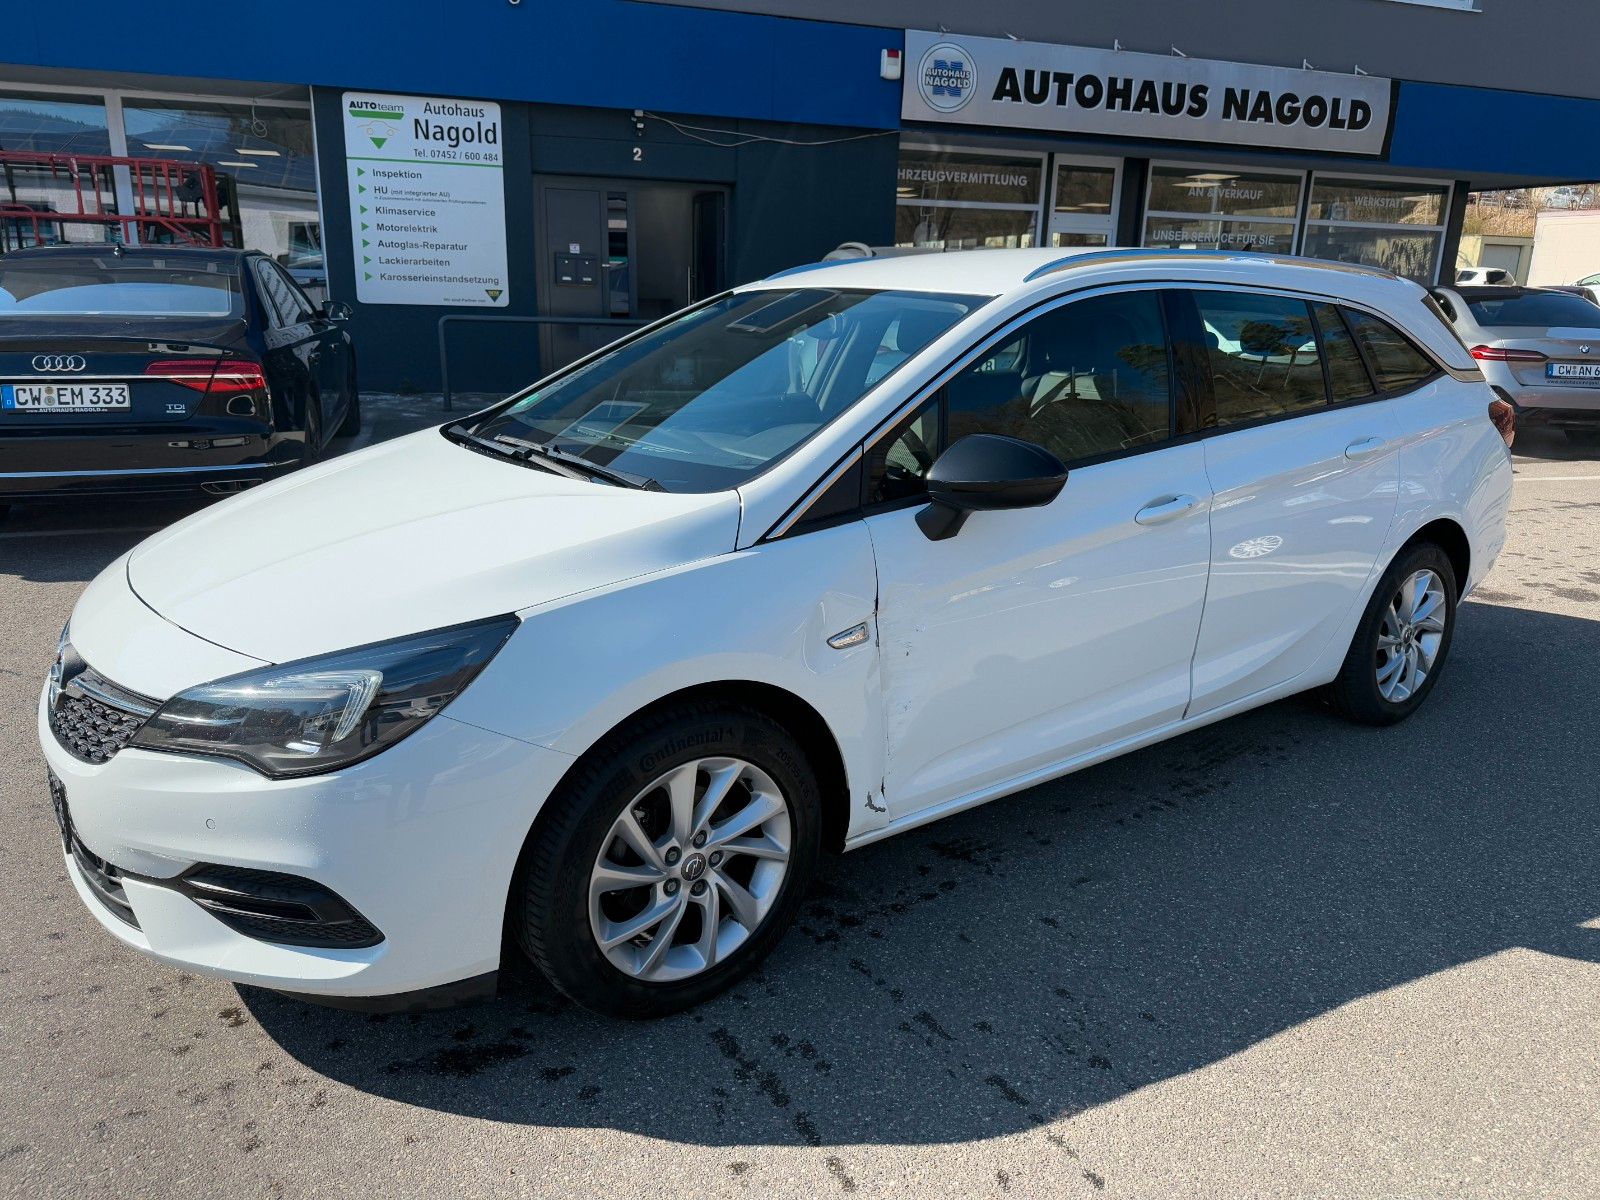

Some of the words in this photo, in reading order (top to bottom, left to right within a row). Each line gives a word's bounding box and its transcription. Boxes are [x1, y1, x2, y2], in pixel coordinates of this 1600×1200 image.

[925, 67, 971, 79] AUTOHAUS
[925, 75, 971, 89] NAGOLD
[349, 100, 404, 112] AUTOteam
[992, 67, 1211, 118] AUTOHAUS
[1222, 87, 1372, 131] NAGOLD
[423, 102, 485, 118] Autohaus
[414, 118, 497, 148] Nagold
[414, 148, 428, 158] Tel.
[430, 150, 457, 160] 07452
[464, 151, 481, 161] 600
[483, 153, 498, 162] 484
[633, 147, 642, 161] 2
[372, 168, 422, 180] Inspektion
[897, 168, 1028, 187] HRZEUGVERMITTLUNG
[374, 186, 388, 195] HU
[1188, 187, 1203, 198] AN
[1217, 188, 1263, 200] VERKAUF
[1354, 195, 1405, 209] WERKSTATT
[375, 206, 436, 217] Klimaservice
[376, 222, 438, 234] Motorelektrik
[1152, 229, 1190, 242] UNSER
[1190, 231, 1233, 244] SERVICE
[1258, 235, 1275, 246] SIE
[377, 239, 468, 251] Autoglas-Reparatur
[378, 256, 451, 267] Lackierarbeiten
[379, 272, 500, 286] Karosserieinstandsetzung
[1558, 365, 1572, 376] CW
[1578, 365, 1592, 376] AN
[15, 387, 42, 406] CW
[56, 387, 83, 406] EM
[89, 387, 127, 405] 333
